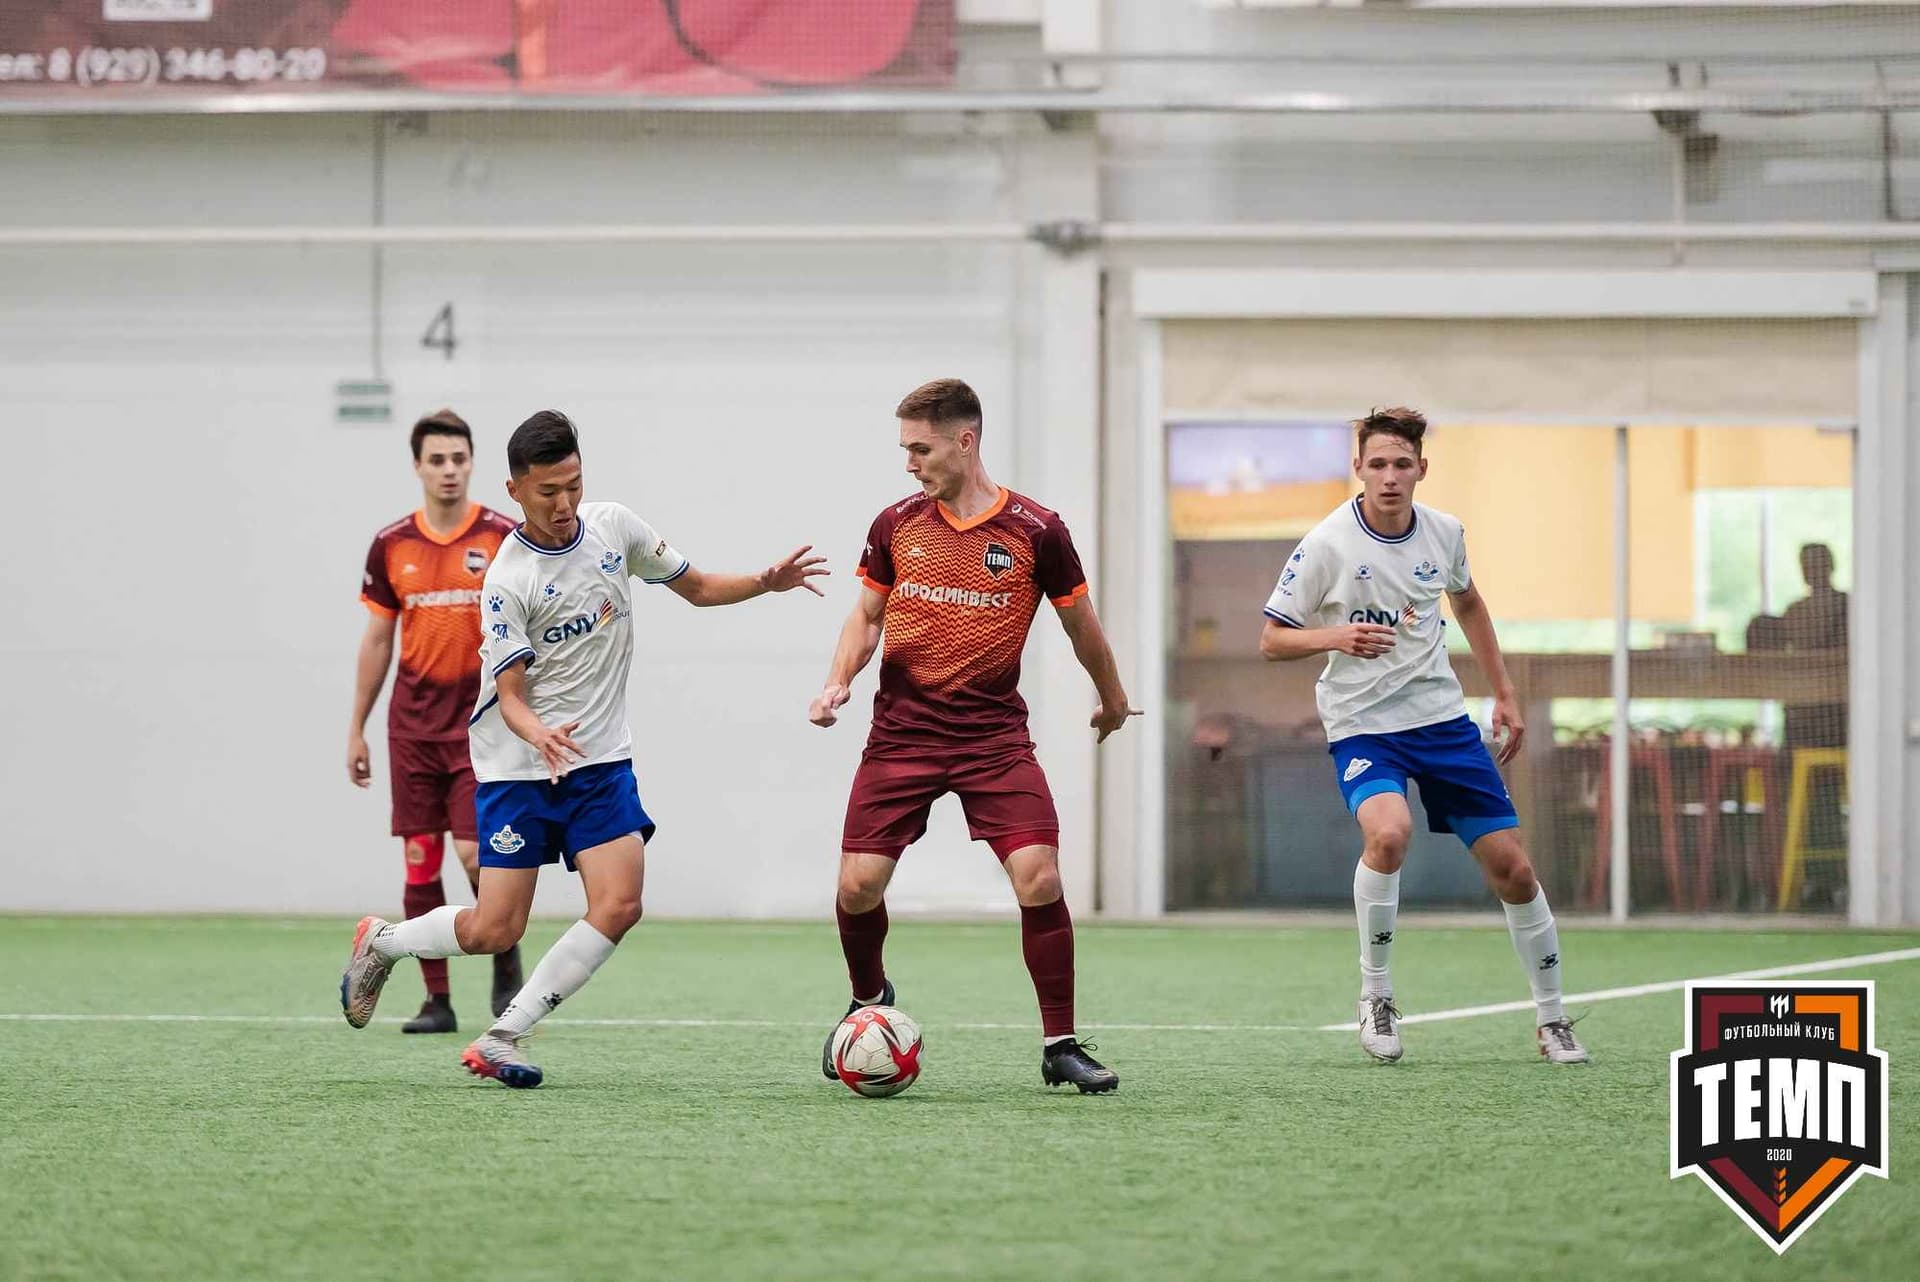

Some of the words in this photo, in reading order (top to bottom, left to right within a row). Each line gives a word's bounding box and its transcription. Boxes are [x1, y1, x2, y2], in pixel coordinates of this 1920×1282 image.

[420, 301, 455, 360] 4
[987, 553, 1011, 569] ТЕМП
[900, 582, 1012, 608] ПРОДИНВЕСТ
[543, 613, 597, 643] GNV
